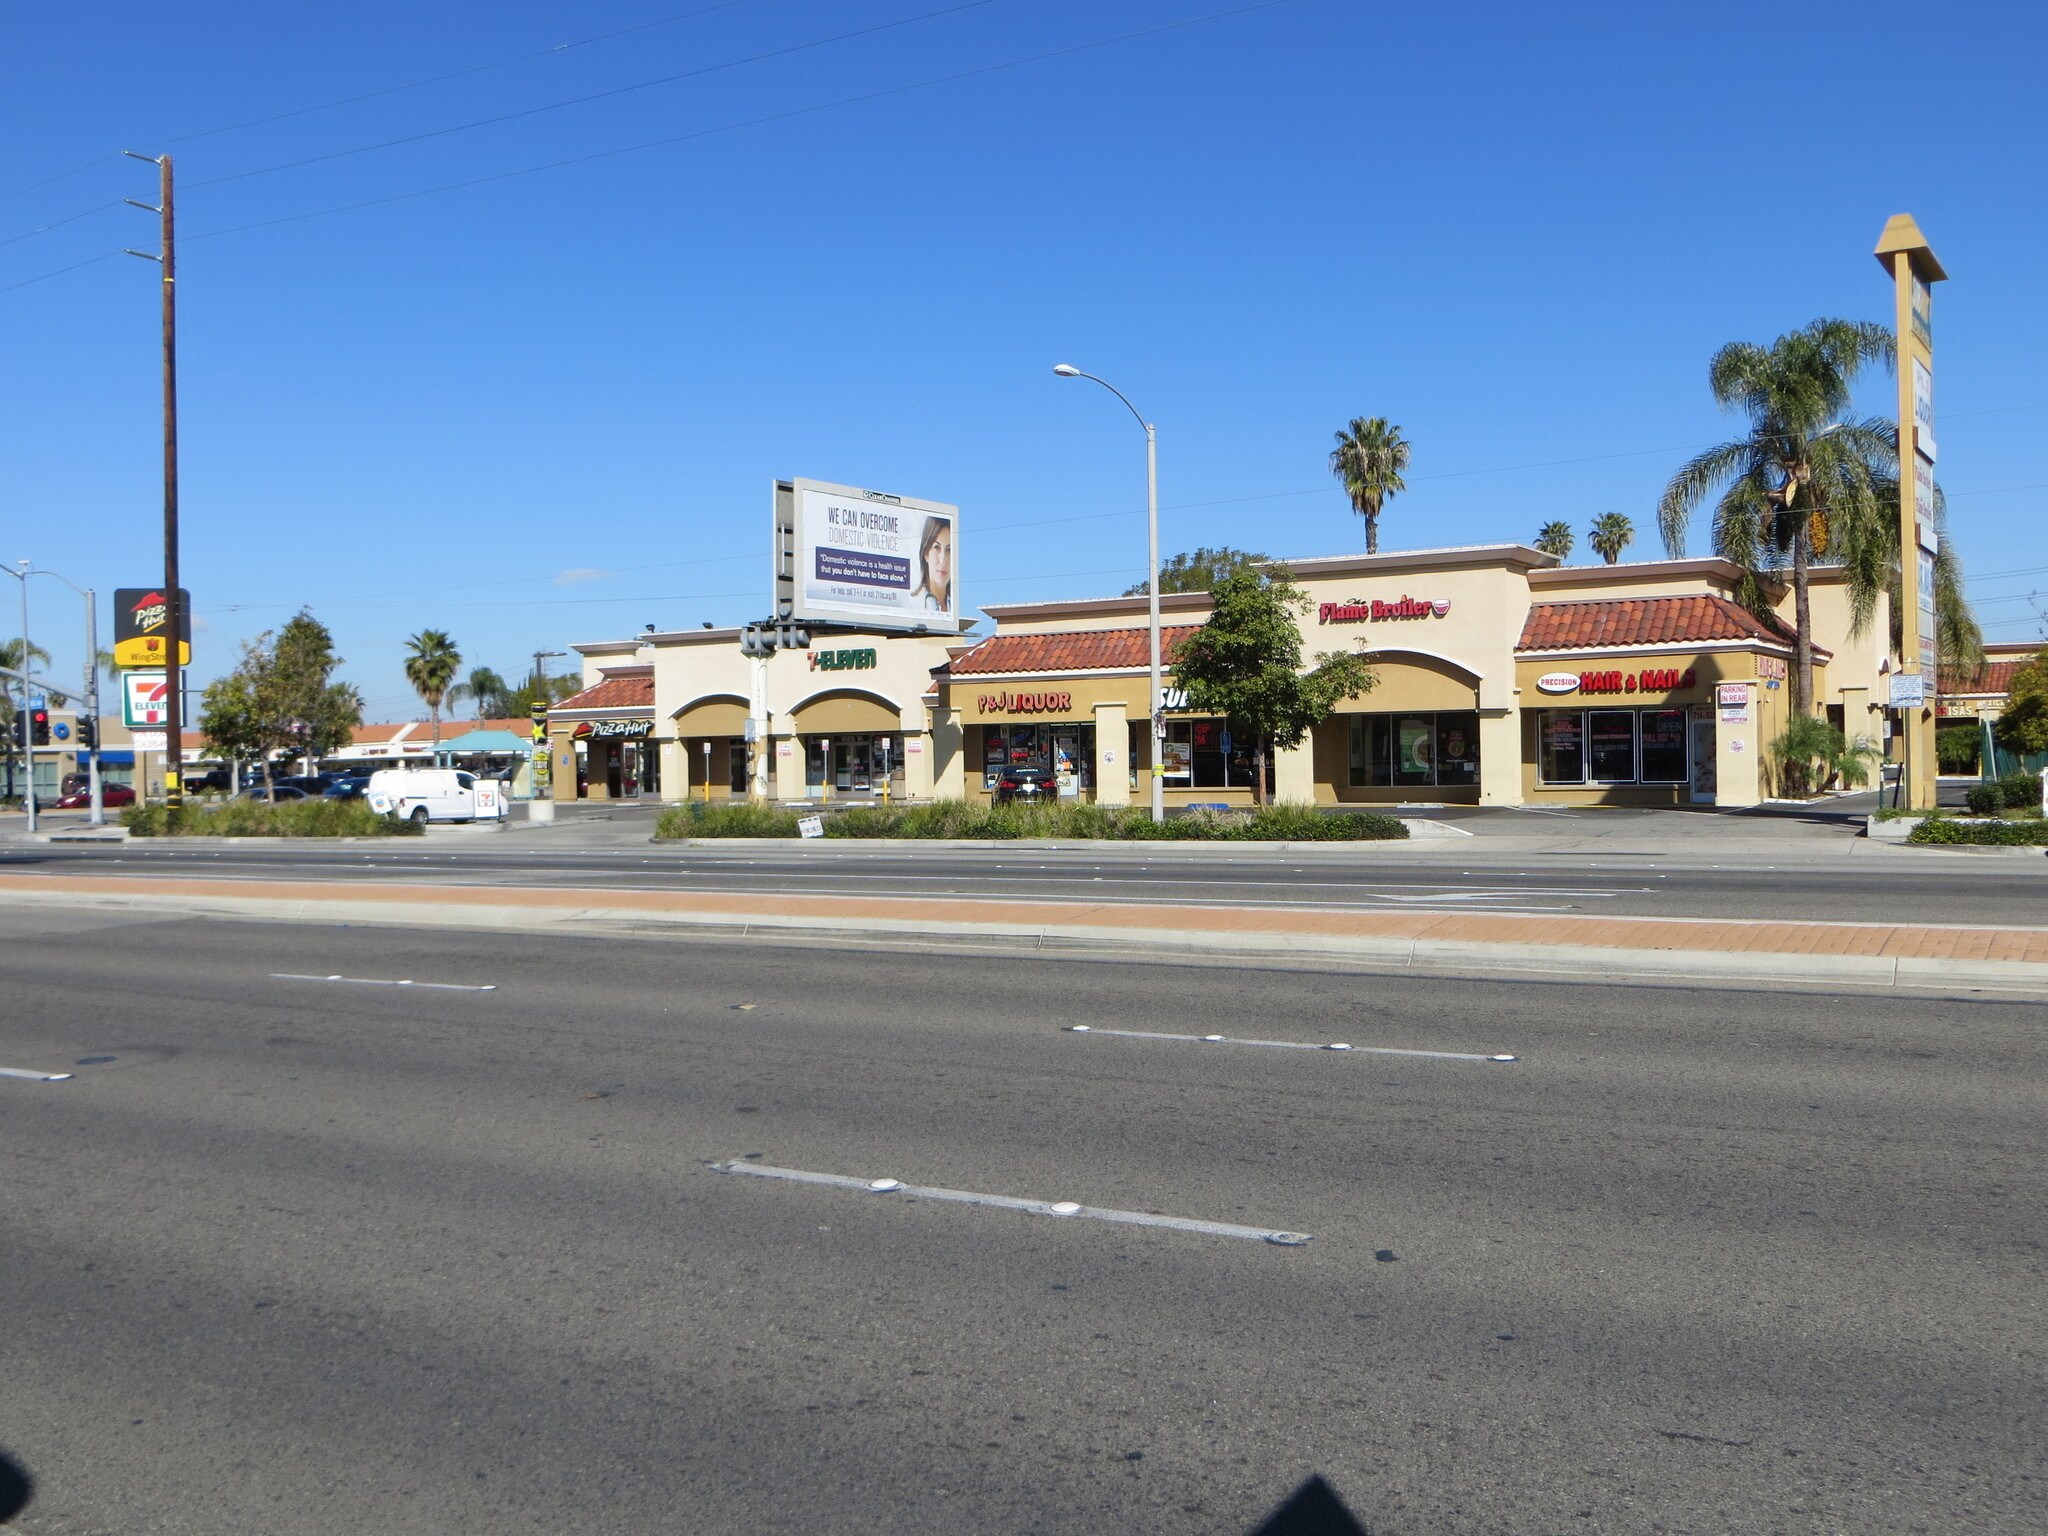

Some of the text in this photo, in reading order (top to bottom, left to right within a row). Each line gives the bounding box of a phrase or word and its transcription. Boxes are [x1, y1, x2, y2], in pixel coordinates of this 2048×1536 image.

[828, 507, 898, 533] WE CAN OVERCOME
[829, 527, 898, 552] DOMESTIC VIOLENCE
[820, 565, 831, 574] that
[832, 568, 842, 576] you
[843, 568, 857, 576] don't
[858, 570, 870, 578] have
[878, 572, 889, 580] face
[848, 557, 868, 567] violence
[868, 560, 873, 568] is
[878, 561, 893, 570] health
[894, 563, 906, 572] issue
[135, 605, 166, 626] Pizz
[1320, 596, 1432, 621] Flame Broiler
[142, 612, 166, 629] Hut
[131, 653, 166, 662] WingStre
[1540, 678, 1578, 686] PRECISION
[1580, 668, 1696, 690] HAIR & NAILS
[1008, 692, 1071, 714] LIQUOR
[1730, 694, 1747, 702] REAR
[592, 721, 652, 736] Pizza Hut
[1657, 722, 1682, 732] OPEN
